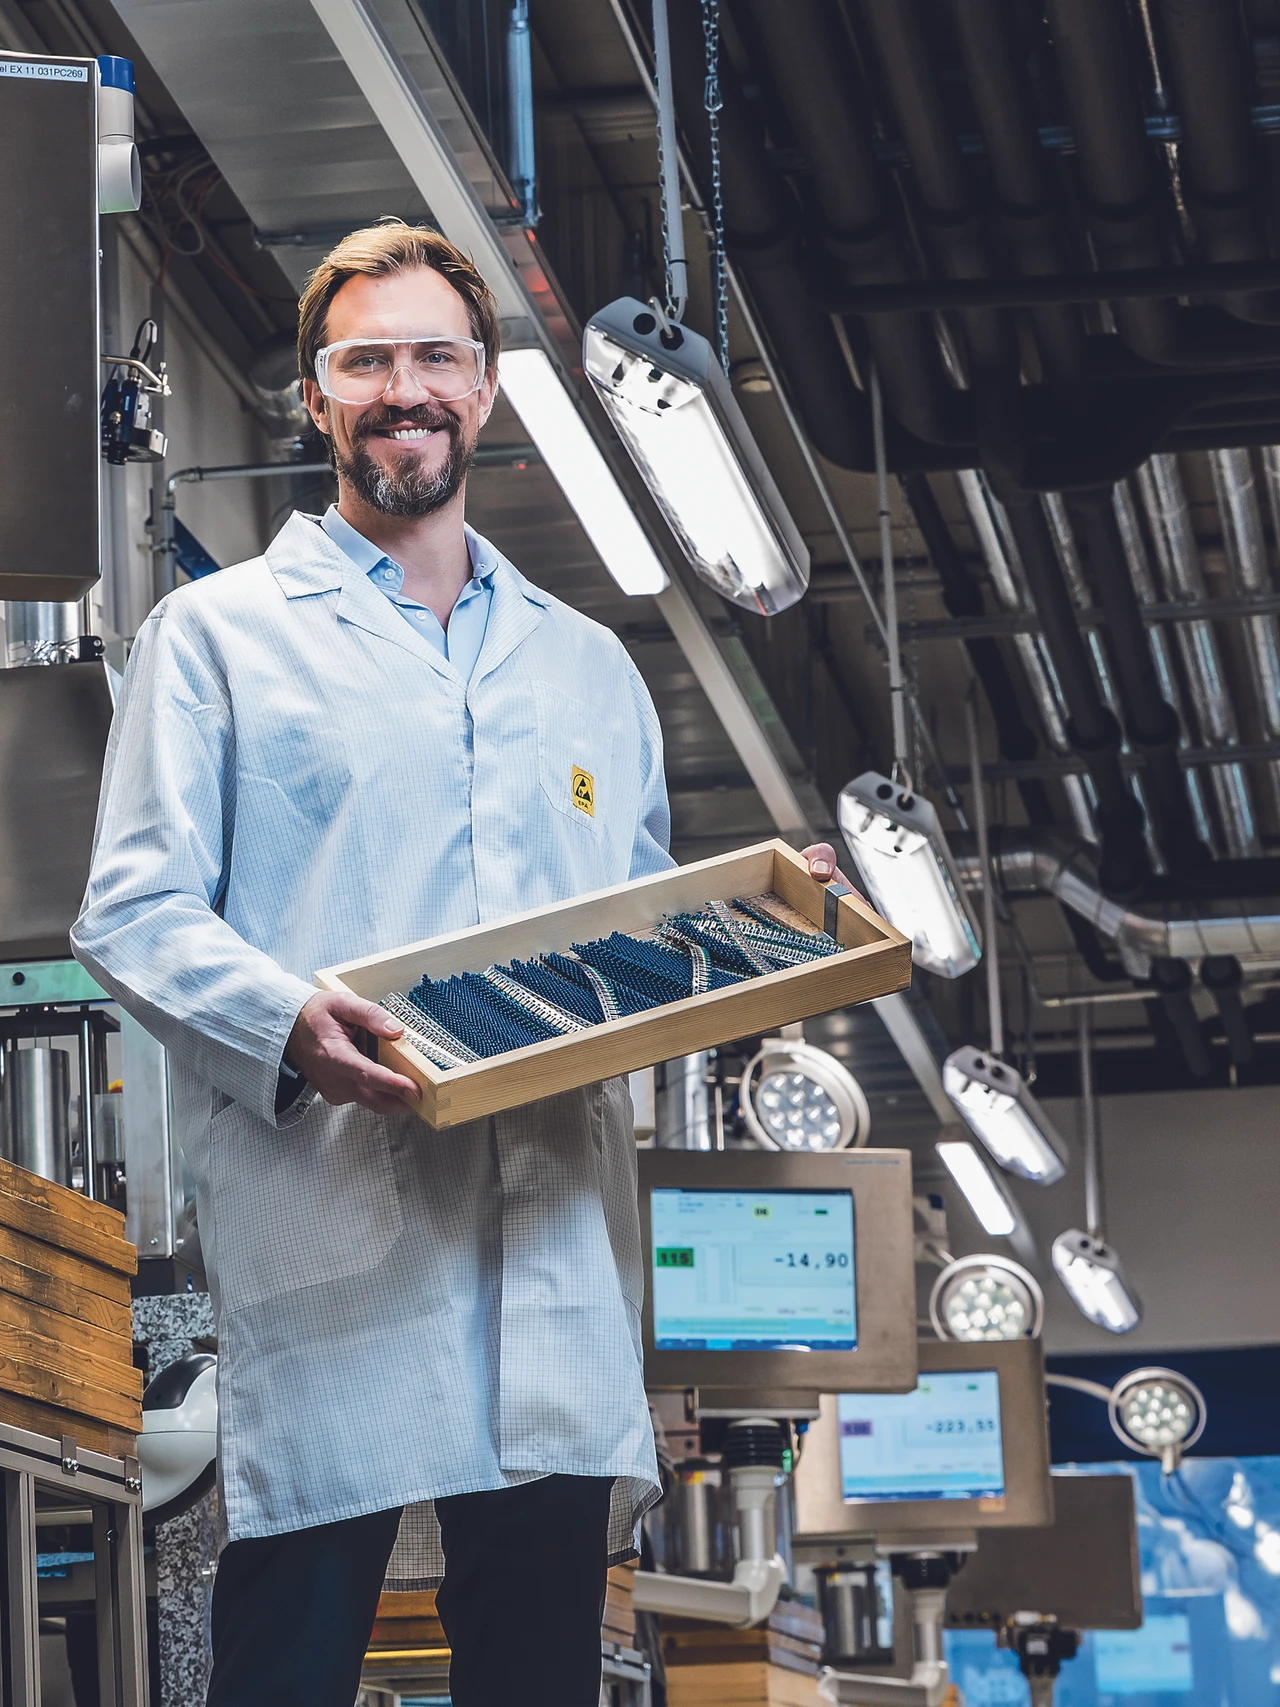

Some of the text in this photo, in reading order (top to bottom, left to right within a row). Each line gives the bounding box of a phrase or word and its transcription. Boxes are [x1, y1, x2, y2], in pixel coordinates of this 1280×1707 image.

[10, 65, 22, 74] EX
[26, 66, 34, 74] 11
[38, 67, 82, 78] 031PC269
[578, 800, 588, 809] EPA
[774, 1252, 849, 1270] -14,90
